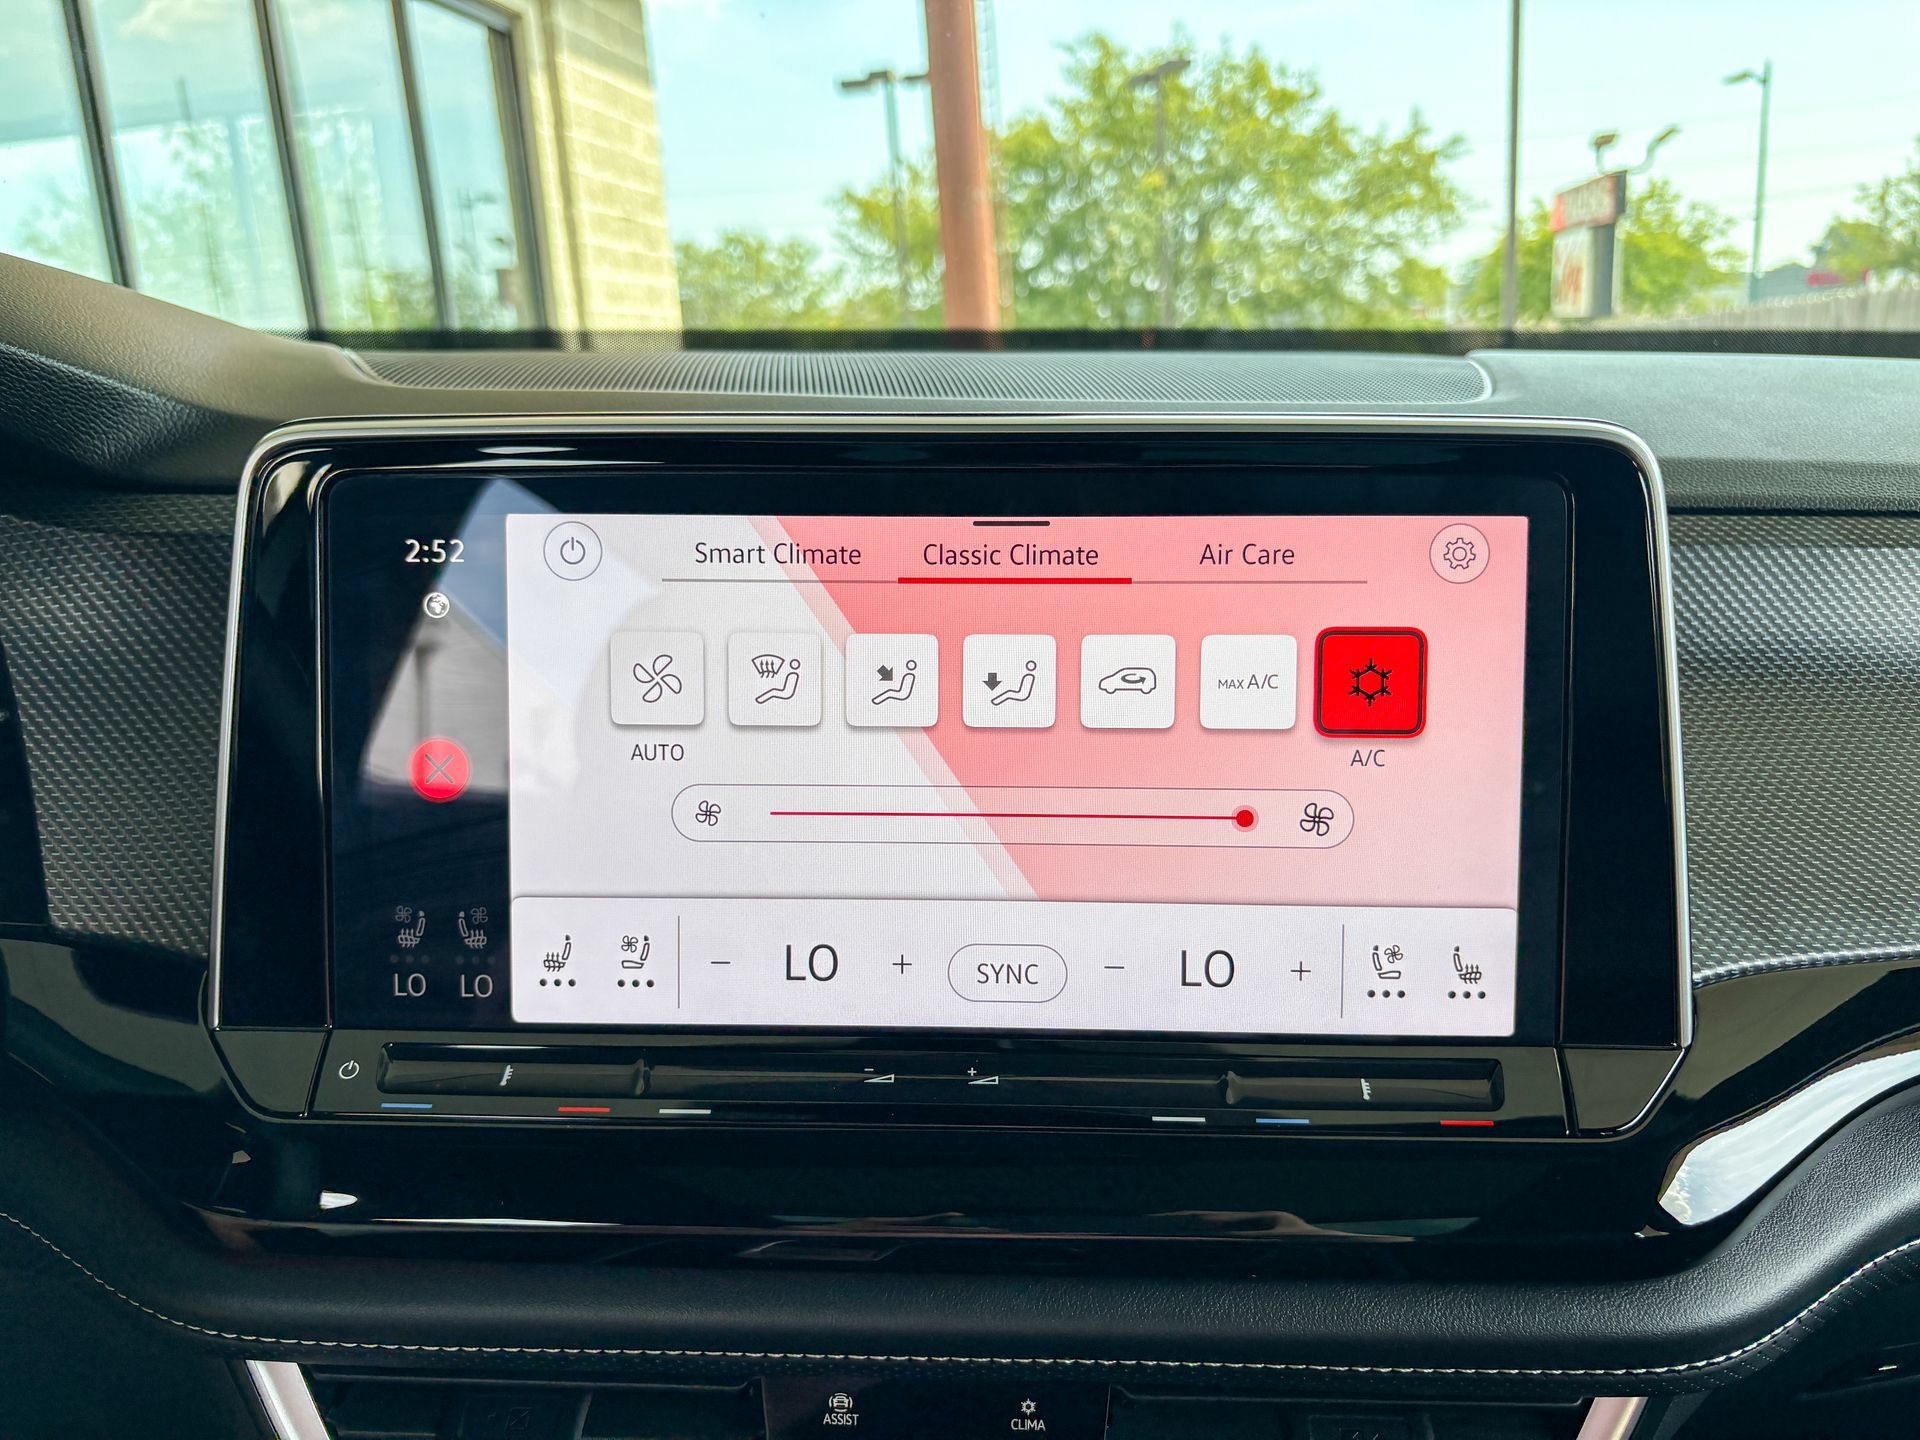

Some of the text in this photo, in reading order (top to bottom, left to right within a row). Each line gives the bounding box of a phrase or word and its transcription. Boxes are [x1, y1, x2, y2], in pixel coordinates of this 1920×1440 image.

[404, 538, 465, 564] 2:52
[695, 542, 862, 565] Smart Climate
[923, 543, 1099, 566] Classic Climate
[1199, 543, 1295, 565] Air Care
[1218, 673, 1279, 690] MAX A/C
[630, 743, 685, 762] AUTO
[1350, 749, 1386, 768] A/C
[785, 943, 839, 982] LO
[977, 962, 1039, 985] SYNC
[1181, 949, 1235, 988] LO
[394, 973, 427, 997] LO
[461, 974, 493, 998] LO
[823, 1413, 860, 1426] ASSIST
[1010, 1418, 1046, 1431] CLIMA
